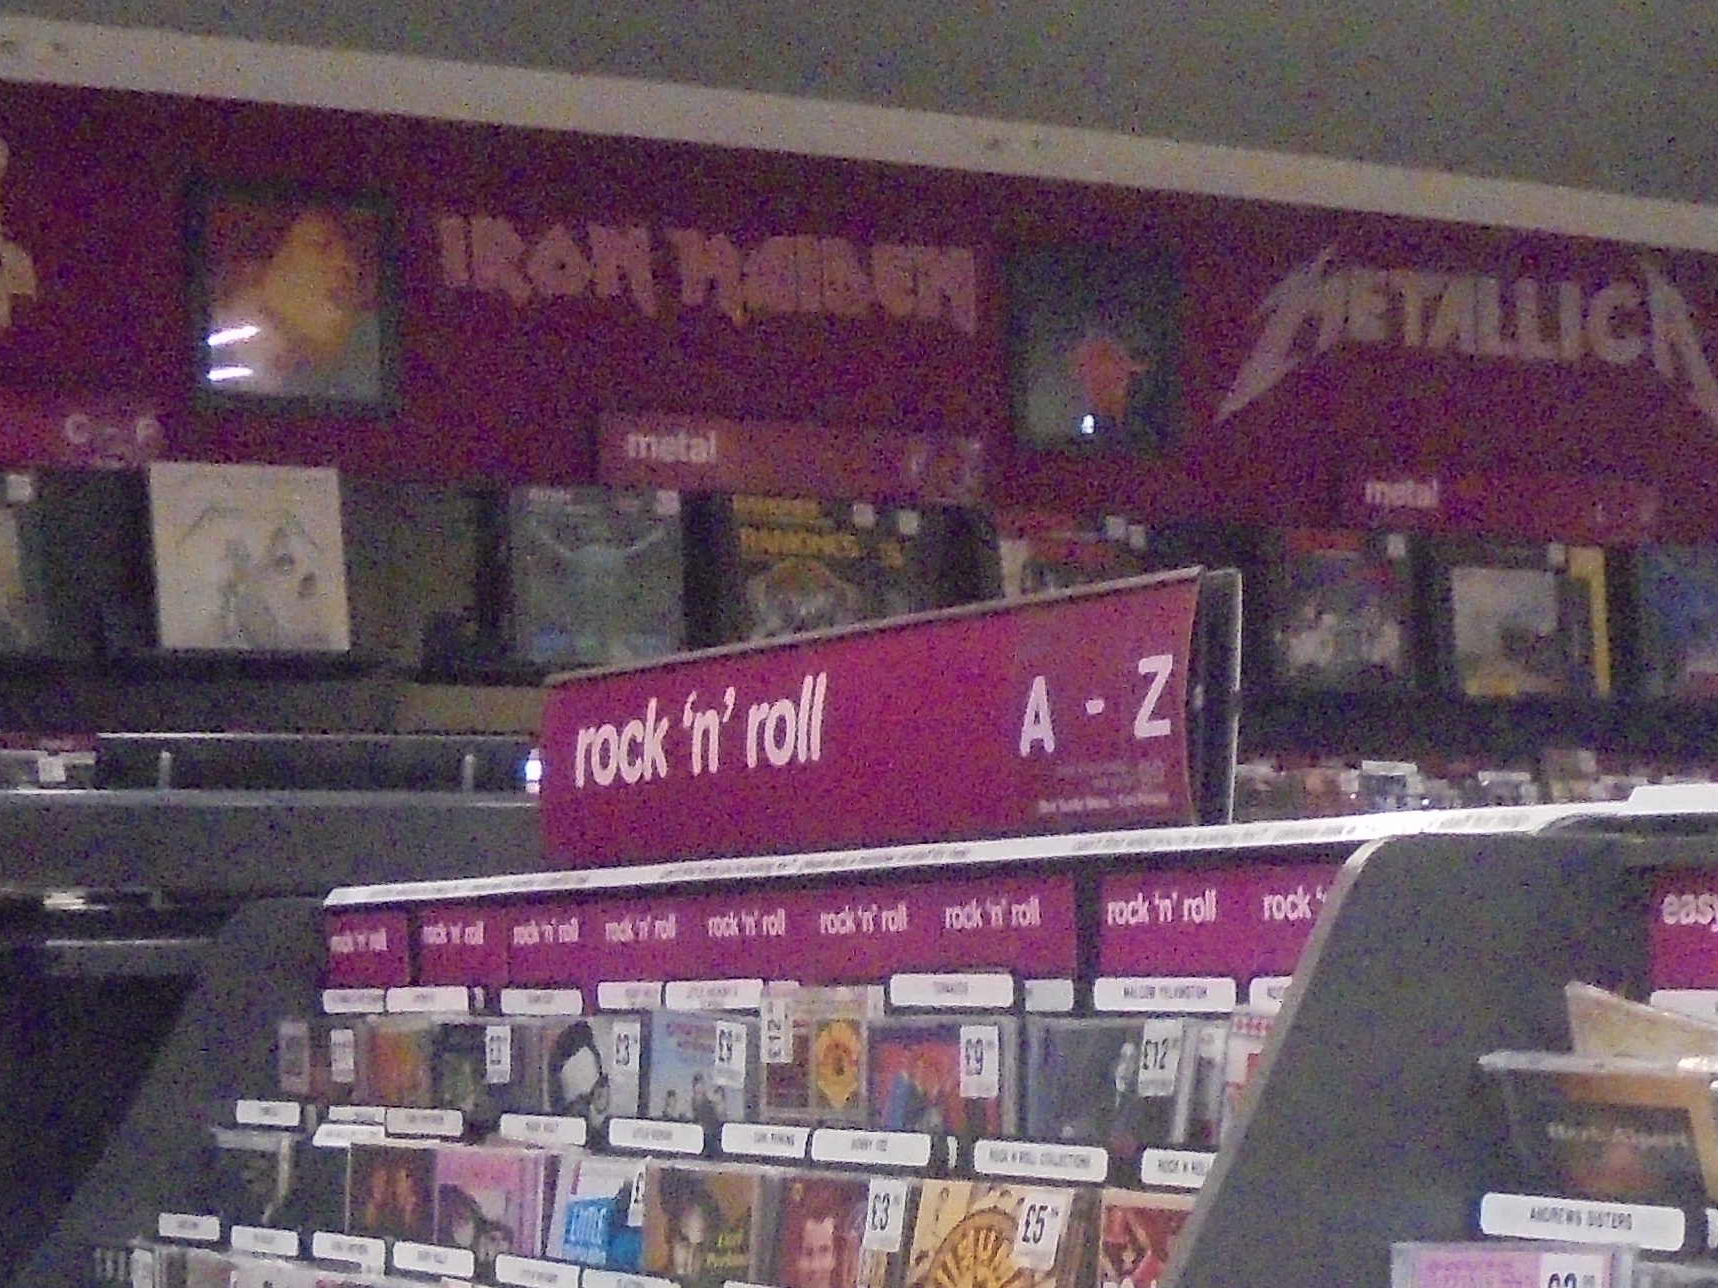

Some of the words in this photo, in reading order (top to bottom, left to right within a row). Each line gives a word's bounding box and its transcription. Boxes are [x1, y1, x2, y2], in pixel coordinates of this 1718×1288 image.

[628, 430, 716, 463] metal
[1019, 676, 1057, 755] A
[1136, 655, 1173, 738] Z
[575, 697, 668, 788] rock
[747, 672, 828, 767] roll
[819, 906, 855, 934] rock
[881, 900, 908, 933] roll
[944, 898, 983, 930] rock
[1011, 895, 1041, 928] roll
[1107, 891, 1149, 926] rock
[1182, 889, 1217, 924] roll
[1262, 885, 1312, 921] rock
[709, 912, 739, 938] rock
[762, 908, 786, 936] roll
